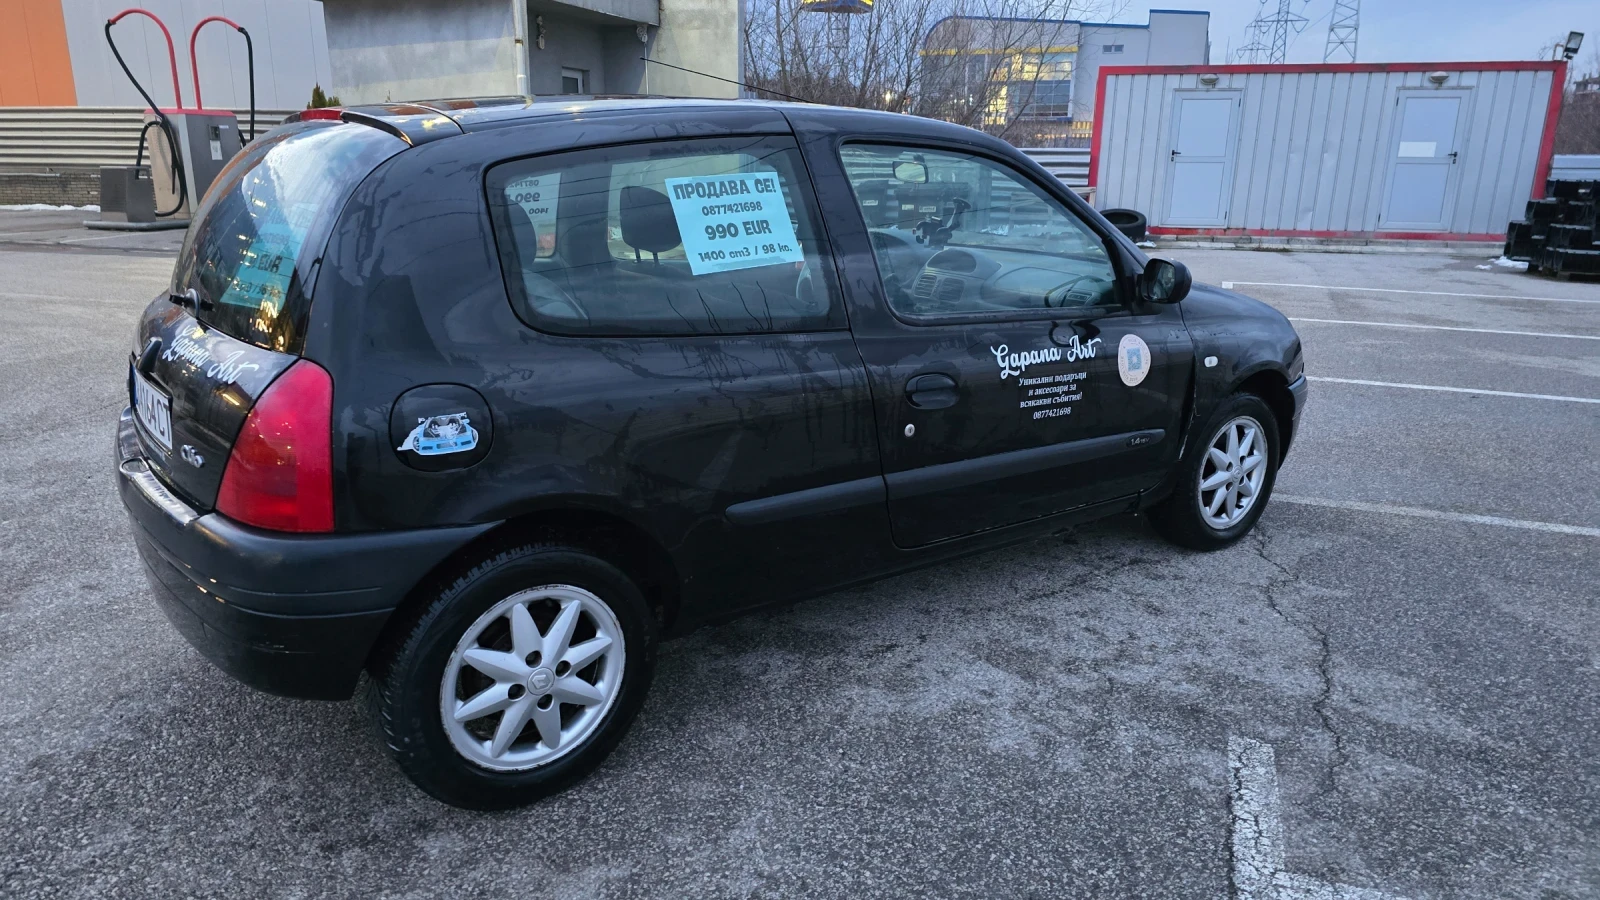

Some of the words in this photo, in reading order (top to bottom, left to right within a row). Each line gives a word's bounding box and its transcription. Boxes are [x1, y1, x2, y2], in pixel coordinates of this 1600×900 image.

[672, 180, 751, 200] ПРОДАВА
[754, 178, 777, 194] СЕ!
[701, 201, 763, 216] 0877421698
[704, 222, 739, 241] 990
[742, 220, 772, 236] EUR
[697, 249, 726, 263] 1400
[728, 247, 751, 259] cm3
[754, 246, 758, 255] /
[762, 243, 776, 254] 98
[990, 344, 1062, 379] Gapana
[1067, 335, 1102, 363] Art
[1018, 375, 1054, 387] Уникални
[1054, 371, 1087, 383] подаръци
[1034, 384, 1069, 396] аксесоари
[1052, 391, 1083, 404] събития!
[1033, 406, 1072, 420] 0877421698
